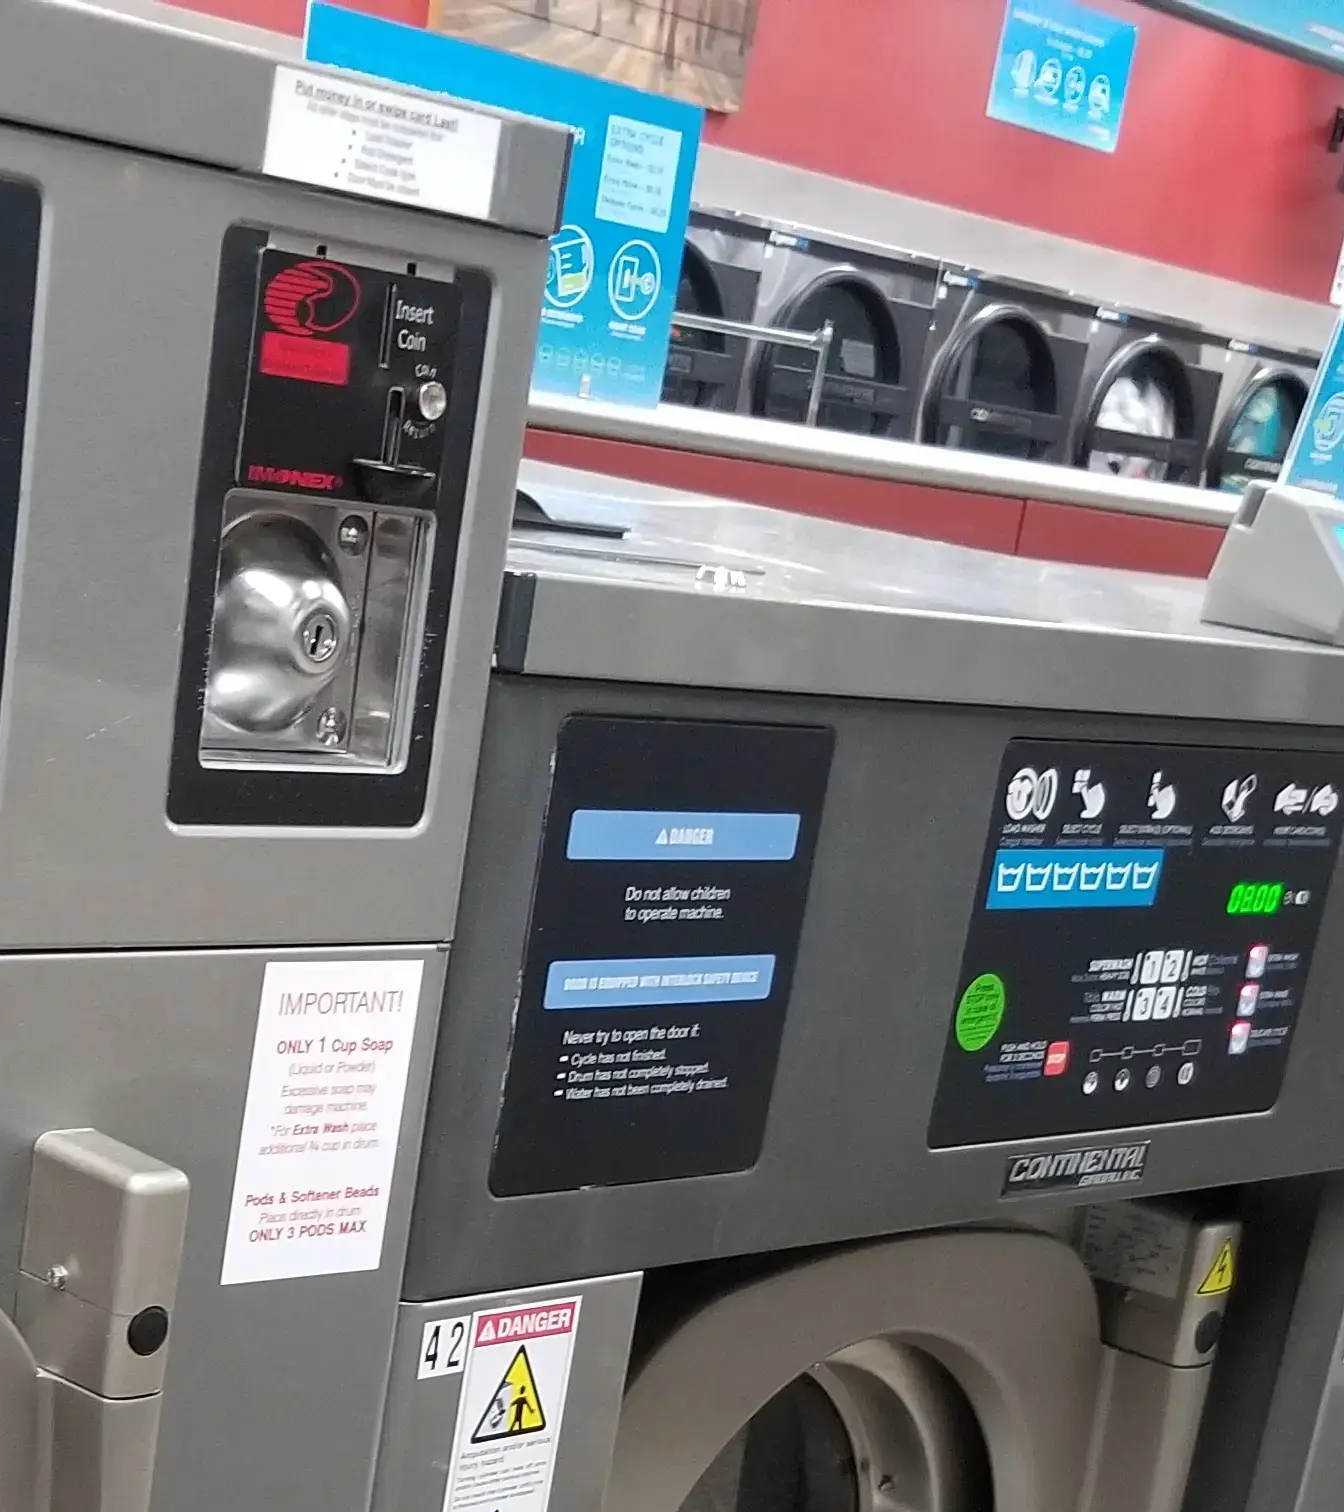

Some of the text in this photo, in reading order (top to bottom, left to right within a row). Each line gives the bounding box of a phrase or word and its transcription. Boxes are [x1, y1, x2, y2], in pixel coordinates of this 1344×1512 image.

[316, 87, 351, 107] money
[379, 103, 407, 120] swipe
[409, 110, 432, 126] card
[395, 300, 435, 325] Insert
[397, 329, 427, 352] Coin
[624, 885, 732, 902] Do not allow children
[624, 906, 637, 921] to
[637, 906, 678, 924] operate
[278, 990, 404, 1017] IMPORTANT!
[562, 1024, 690, 1046] Never try to open the door
[276, 1036, 394, 1056] ONLY 1 Cup Soap
[570, 1053, 597, 1069] Cycle
[597, 1052, 615, 1064] has
[615, 1051, 631, 1063] not
[567, 1070, 594, 1083] Drum
[594, 1069, 612, 1081] has
[612, 1068, 628, 1080] not
[628, 1065, 674, 1080] completely
[330, 1085, 355, 1096] soap
[356, 1084, 377, 1096] may
[565, 1087, 594, 1100] Water
[593, 1086, 611, 1098] has
[611, 1085, 627, 1097] not
[627, 1083, 650, 1096] been
[650, 1080, 695, 1095] completely
[284, 1104, 324, 1117] damage
[292, 1124, 319, 1136] Extra
[323, 1122, 349, 1134] Wash
[245, 1184, 380, 1207] Pods & Softener Beads
[258, 1211, 287, 1224] Place
[288, 1209, 322, 1221] directly
[249, 1220, 368, 1243] ONLY 3 PODS MAX
[497, 1308, 572, 1339] DANGER
